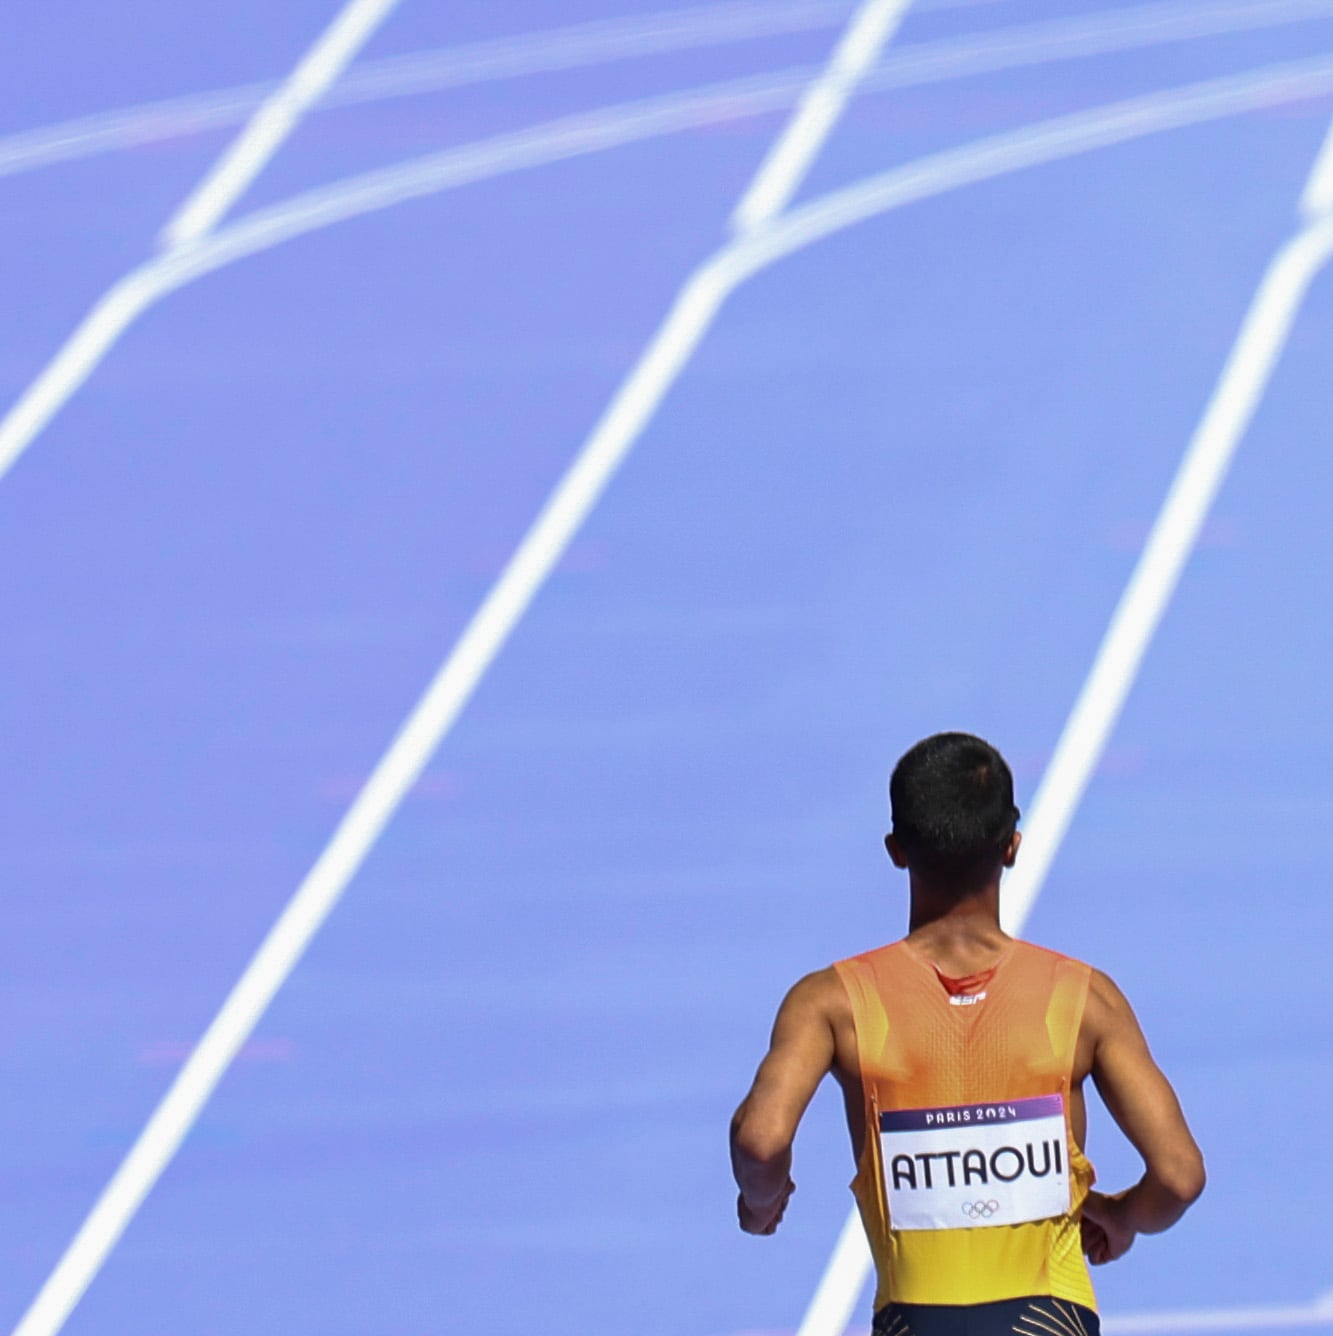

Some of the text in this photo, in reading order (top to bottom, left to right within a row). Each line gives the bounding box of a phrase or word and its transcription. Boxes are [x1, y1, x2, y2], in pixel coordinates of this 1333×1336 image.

[926, 1105, 1017, 1125] PARIS 2024
[891, 1139, 1062, 1190] ATTAOUI
